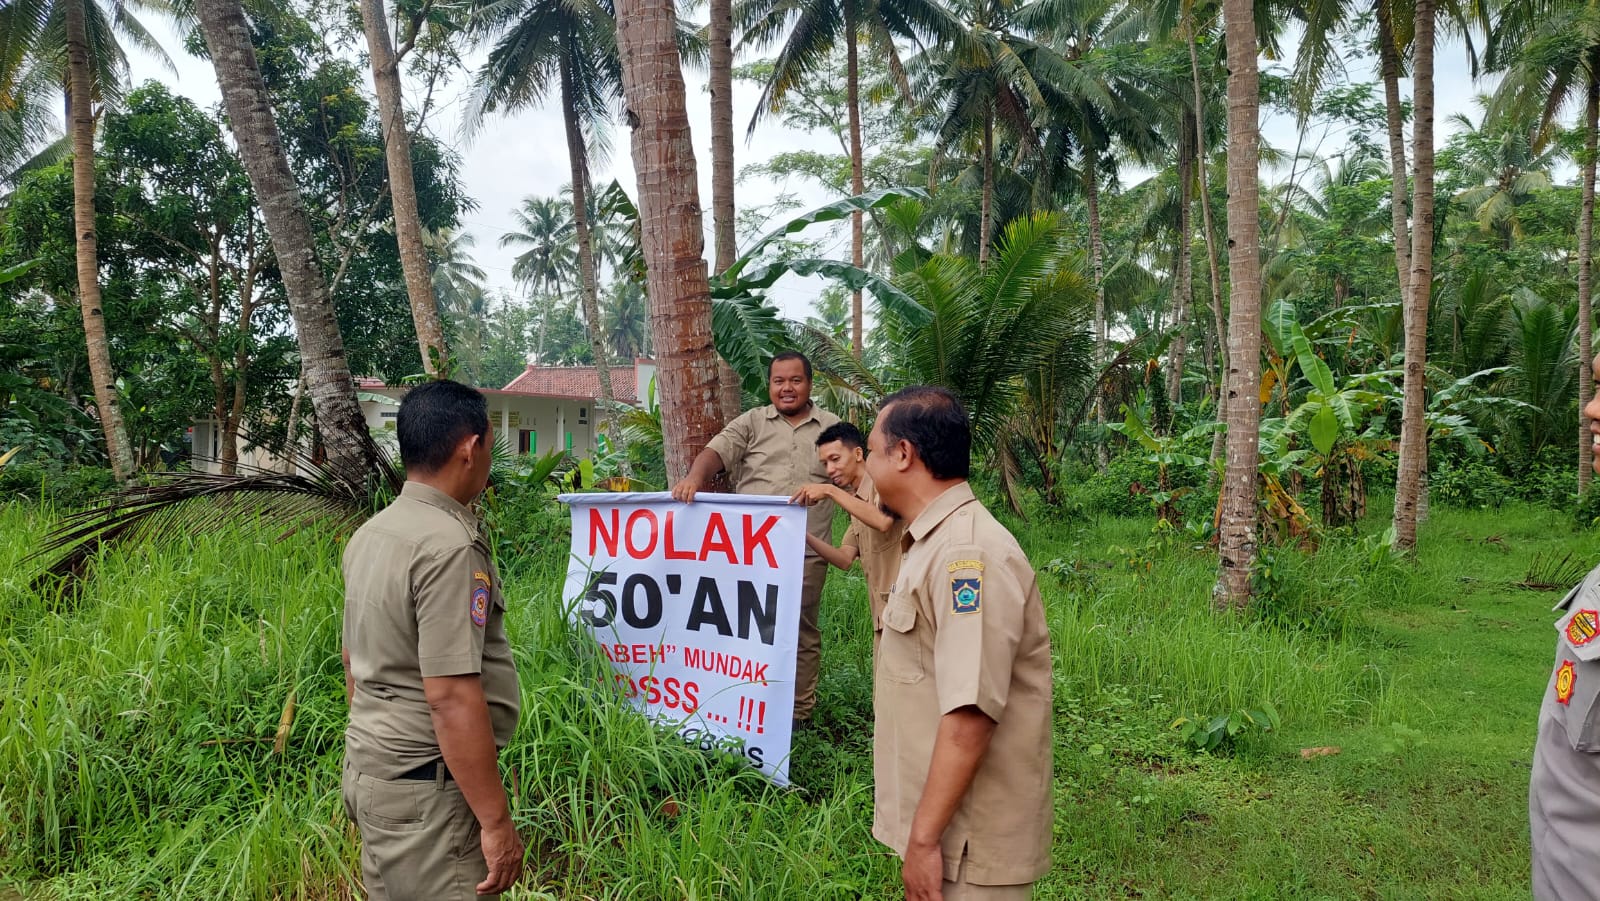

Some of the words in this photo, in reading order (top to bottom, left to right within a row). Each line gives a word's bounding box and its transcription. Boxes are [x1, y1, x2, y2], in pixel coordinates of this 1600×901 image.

[589, 508, 782, 569] NOLAK
[581, 571, 779, 646] 50'AN
[684, 647, 769, 686] MUNDAK
[598, 673, 700, 714] OSSS
